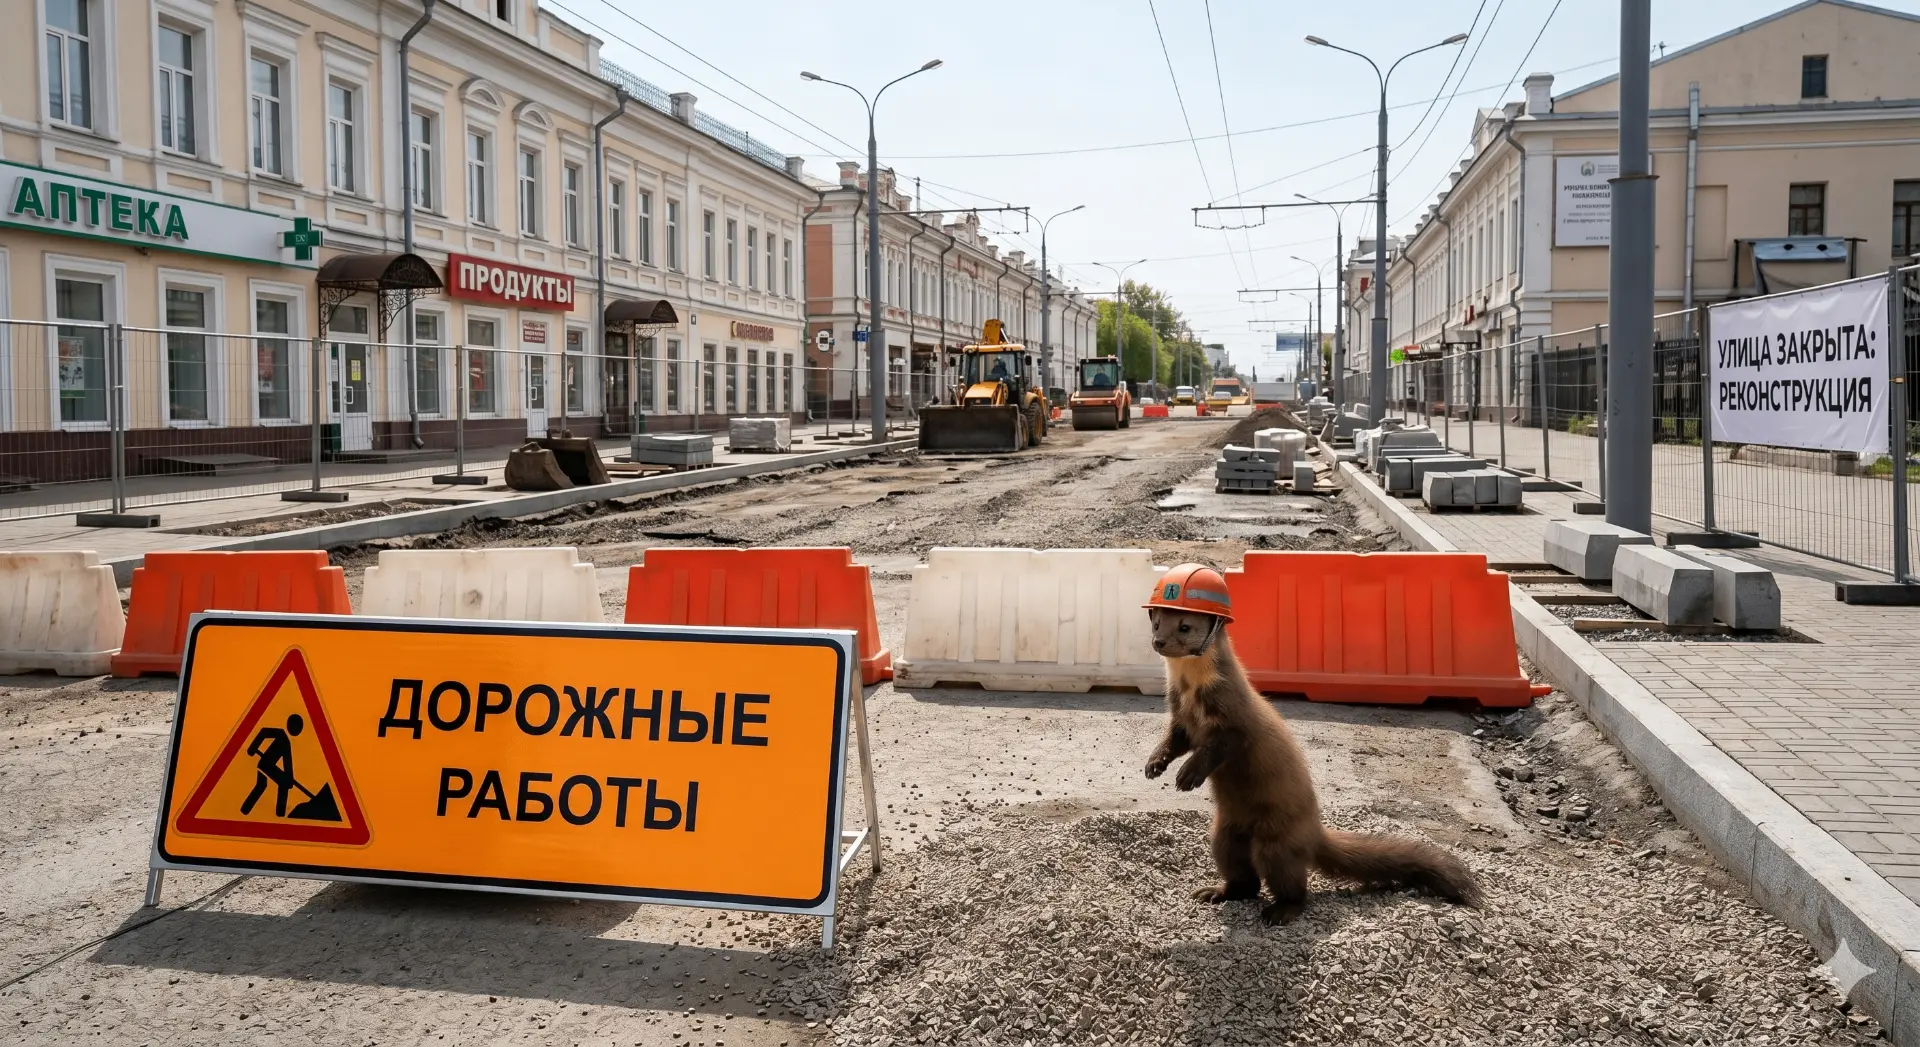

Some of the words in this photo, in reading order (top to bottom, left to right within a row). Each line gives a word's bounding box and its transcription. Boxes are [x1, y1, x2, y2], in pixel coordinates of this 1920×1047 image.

[12, 176, 189, 240] АПТЕКА
[460, 261, 572, 304] ПРОДУКТЫ
[1717, 335, 1772, 372] УЛИЦА
[1776, 324, 1876, 366] ЗАКРЫТА:
[1719, 377, 1872, 418] РЕКОНСТРУКЦИЯ
[377, 677, 771, 747] ДОРОЖНЫЕ
[436, 767, 700, 832] РАБОТЫ
